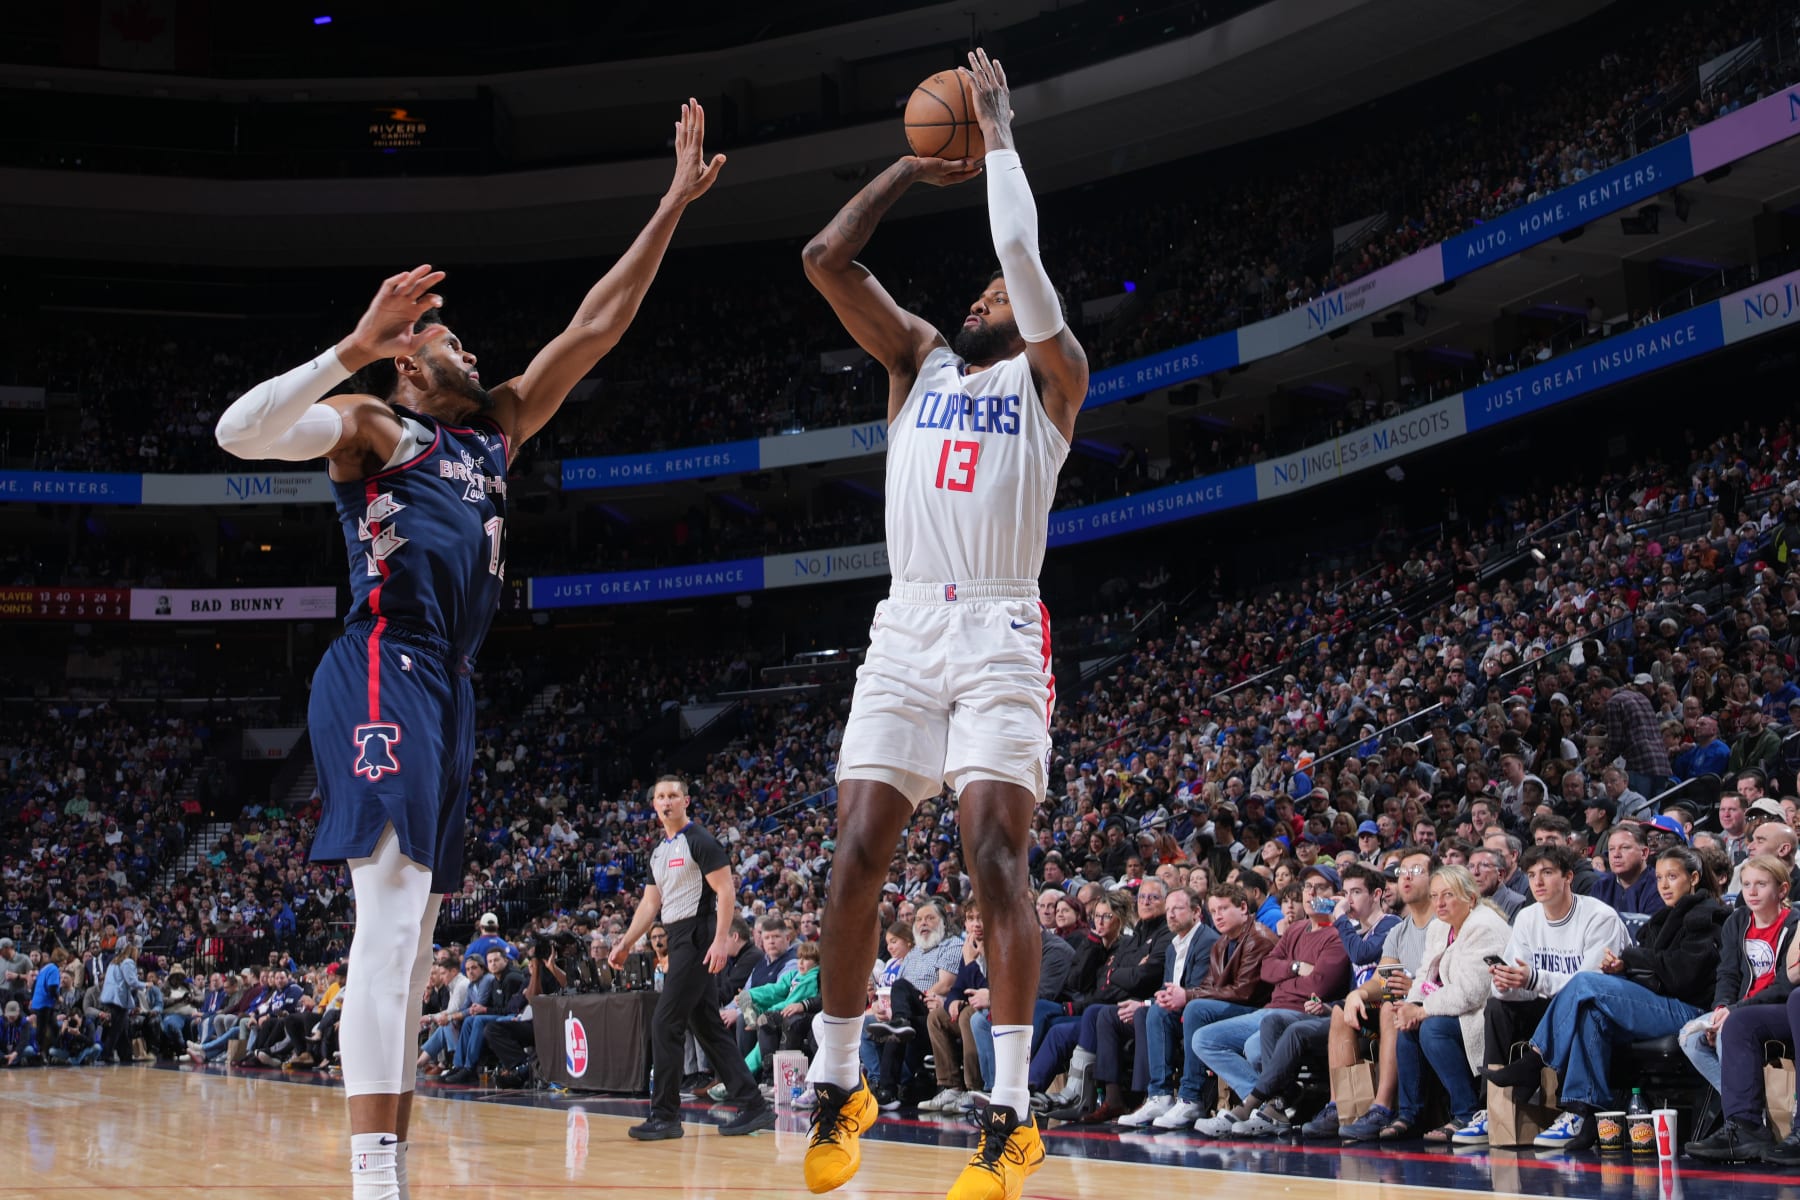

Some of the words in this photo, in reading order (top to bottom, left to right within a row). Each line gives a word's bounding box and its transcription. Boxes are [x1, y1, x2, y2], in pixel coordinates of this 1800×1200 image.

[369, 124, 427, 133] RIVERS
[1467, 230, 1512, 259] AUTO.
[1520, 206, 1570, 236] HOME.
[1579, 165, 1662, 212] RENTERS.
[1307, 293, 1345, 331] NJM
[1744, 292, 1778, 324] NO
[1088, 378, 1131, 398] HOME.
[1137, 354, 1205, 383] RENTERS.
[1486, 386, 1524, 412] JUST
[1531, 364, 1585, 395] GREAT
[1592, 325, 1697, 375] INSURANCE
[915, 390, 1021, 435] CLIPPERS
[1273, 463, 1298, 486] NO
[1300, 441, 1359, 484] JINGLES
[1373, 409, 1449, 454] MASCOTS
[610, 463, 659, 478] HOME.
[665, 453, 736, 472] RENTERS.
[935, 439, 980, 493] 13
[33, 481, 115, 495] RENTERS.
[225, 476, 272, 500] NJM
[273, 477, 312, 486] Insurance
[273, 486, 298, 496] Group
[461, 482, 486, 503] Love
[1047, 518, 1085, 537] JUST
[1092, 507, 1135, 528] GREAT
[1141, 485, 1224, 516] INSURANCE
[794, 557, 821, 577] NO
[823, 550, 890, 577] JINGLES
[554, 584, 593, 597] JUST
[600, 580, 652, 594] GREAT
[658, 570, 744, 590] INSURANCE
[40, 592, 50, 602] 13
[56, 592, 71, 602] 40
[80, 592, 85, 602] 1
[94, 592, 107, 603] 24
[60, 605, 66, 614] 2
[78, 604, 84, 615] 5
[96, 605, 103, 615] 0
[191, 599, 222, 612] BAD
[230, 597, 284, 611] BUNNY
